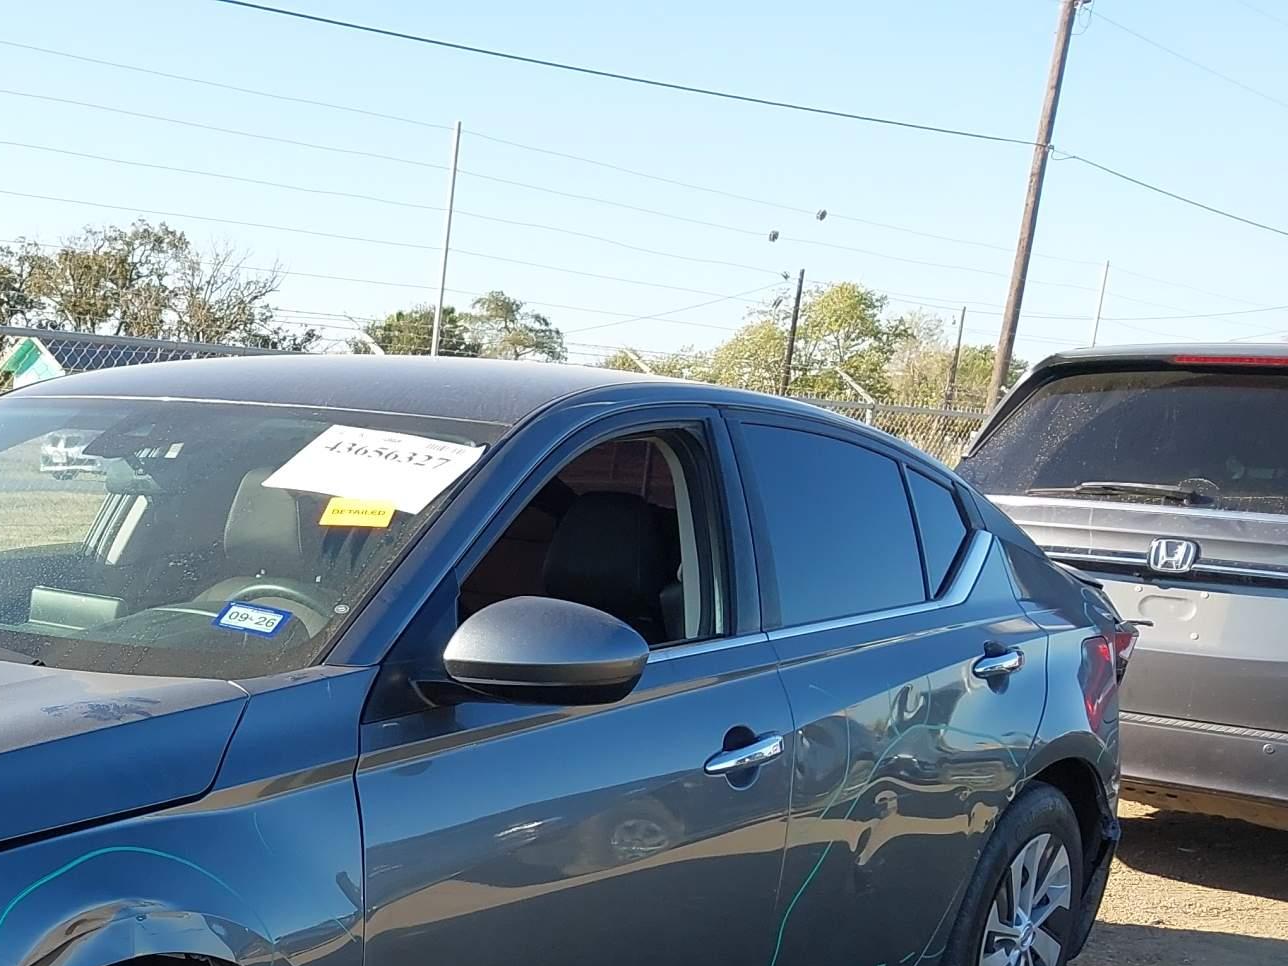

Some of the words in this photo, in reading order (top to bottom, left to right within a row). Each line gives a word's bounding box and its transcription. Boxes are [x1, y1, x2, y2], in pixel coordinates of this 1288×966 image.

[324, 440, 452, 470] 43656327
[331, 508, 387, 516] DETAILED
[228, 611, 249, 622] 09
[254, 616, 277, 628] 26
